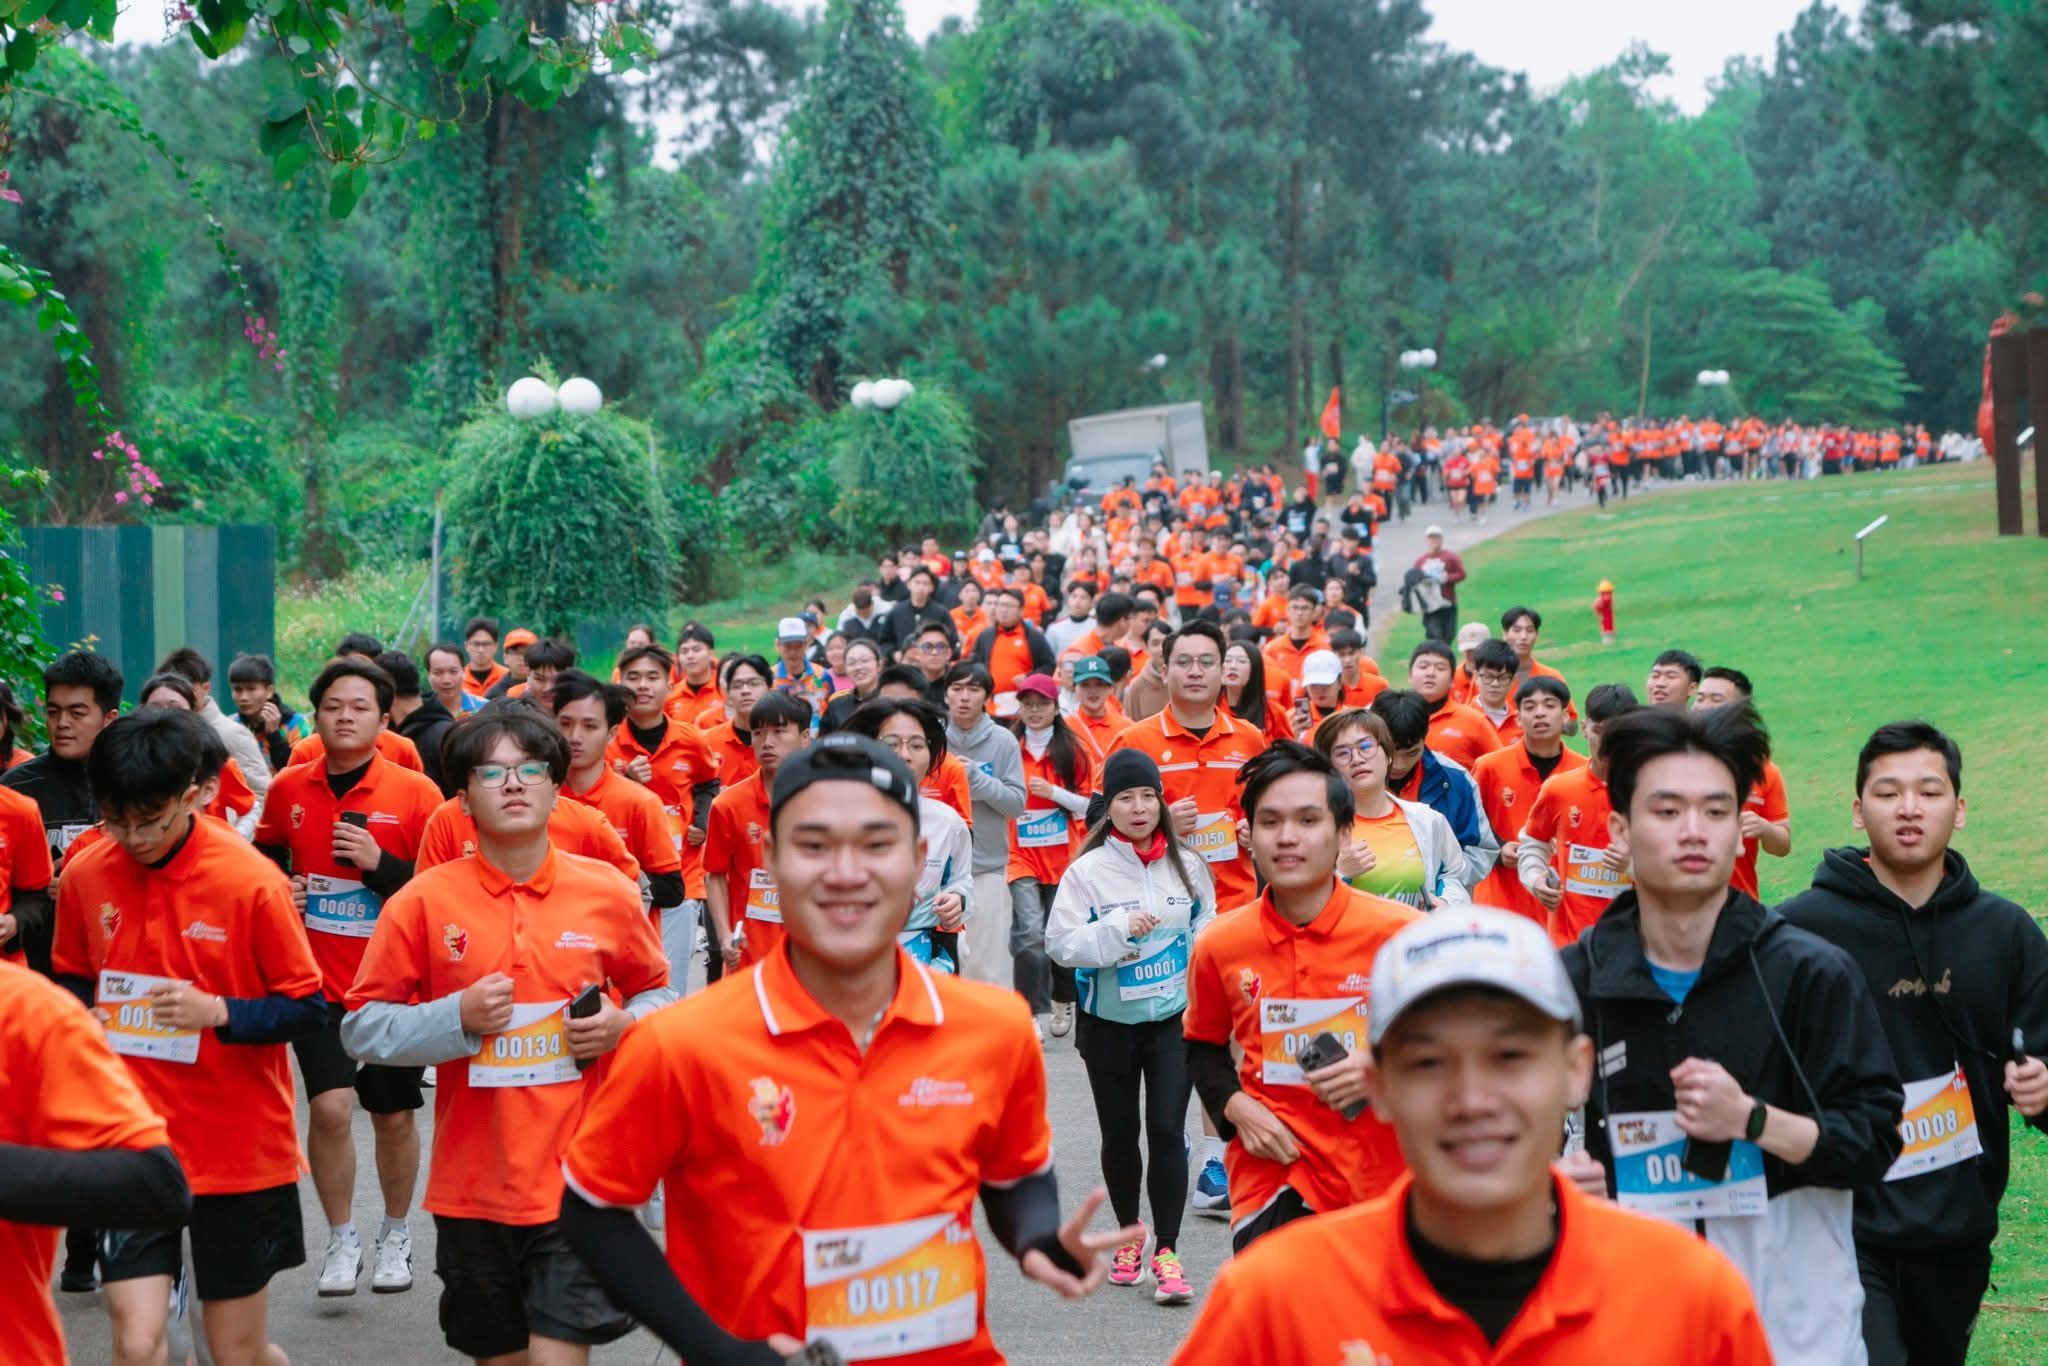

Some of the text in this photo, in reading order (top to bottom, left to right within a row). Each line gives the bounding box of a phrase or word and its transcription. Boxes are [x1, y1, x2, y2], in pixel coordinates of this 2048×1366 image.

[319, 898, 366, 918] 00089
[1134, 959, 1176, 980] 00001
[120, 1004, 177, 1033] 001
[495, 1033, 560, 1059] 00134
[1284, 1031, 1356, 1056] 008
[848, 1267, 941, 1317] 00117
